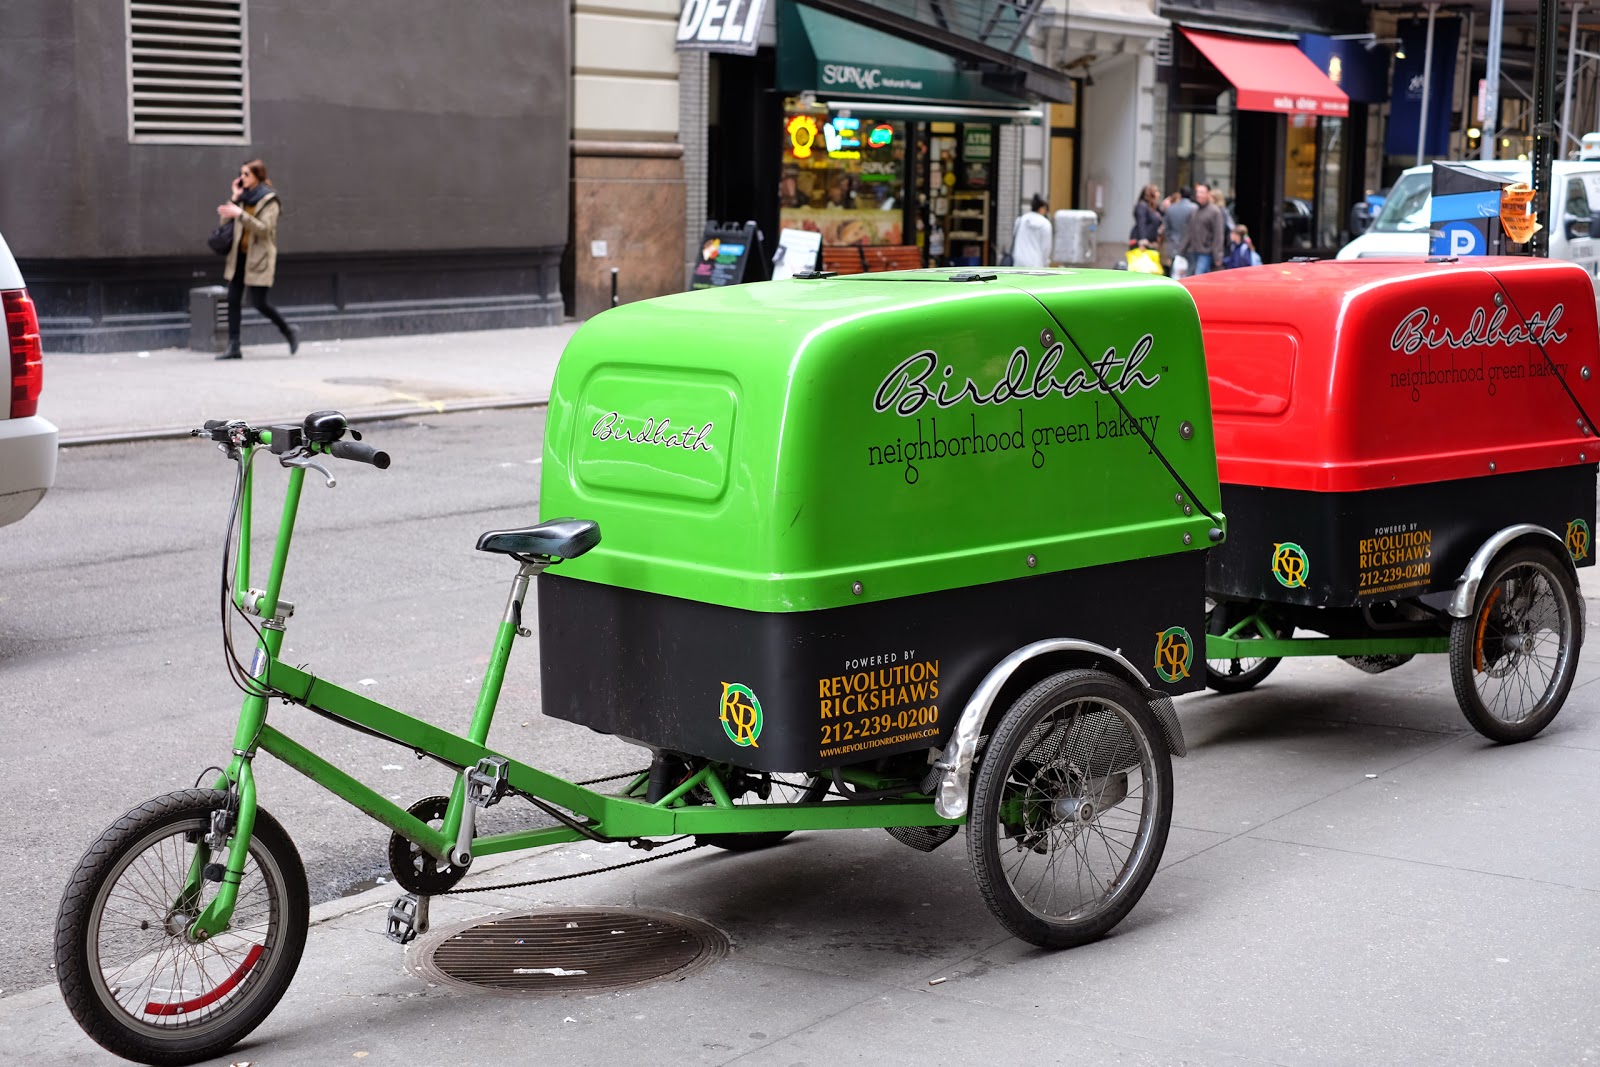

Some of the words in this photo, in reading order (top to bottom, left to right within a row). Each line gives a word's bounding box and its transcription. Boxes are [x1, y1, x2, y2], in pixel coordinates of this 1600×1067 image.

[677, 0, 761, 42] DELI
[966, 133, 991, 144] ATM
[1450, 229, 1475, 255] P
[1390, 303, 1567, 355] Birdbath
[872, 333, 1161, 417] Birdbath
[1390, 351, 1485, 402] neighborhood
[1487, 364, 1526, 396] green
[591, 411, 713, 451] Birdbath
[868, 408, 1025, 484] neighborhood
[1031, 421, 1090, 469] green
[1095, 400, 1160, 455] bakery
[1359, 530, 1432, 554] REVOLUTION
[1374, 524, 1406, 536] POWERED
[1409, 523, 1417, 531] BY
[1359, 544, 1432, 569] RICKSHAWS
[1358, 579, 1431, 596] WWW.REVOLUTIONRICKSHAWS.COM
[1359, 562, 1431, 587] 212-239-0200
[845, 653, 897, 670] POWERED
[904, 650, 915, 660] BY
[819, 659, 939, 698] REVOLUTION
[820, 680, 939, 719] RICKSHAWS
[819, 727, 940, 757] WWW.REVOLUTIONRICKSHAWS.COM
[820, 705, 939, 745] 212-239-0200
